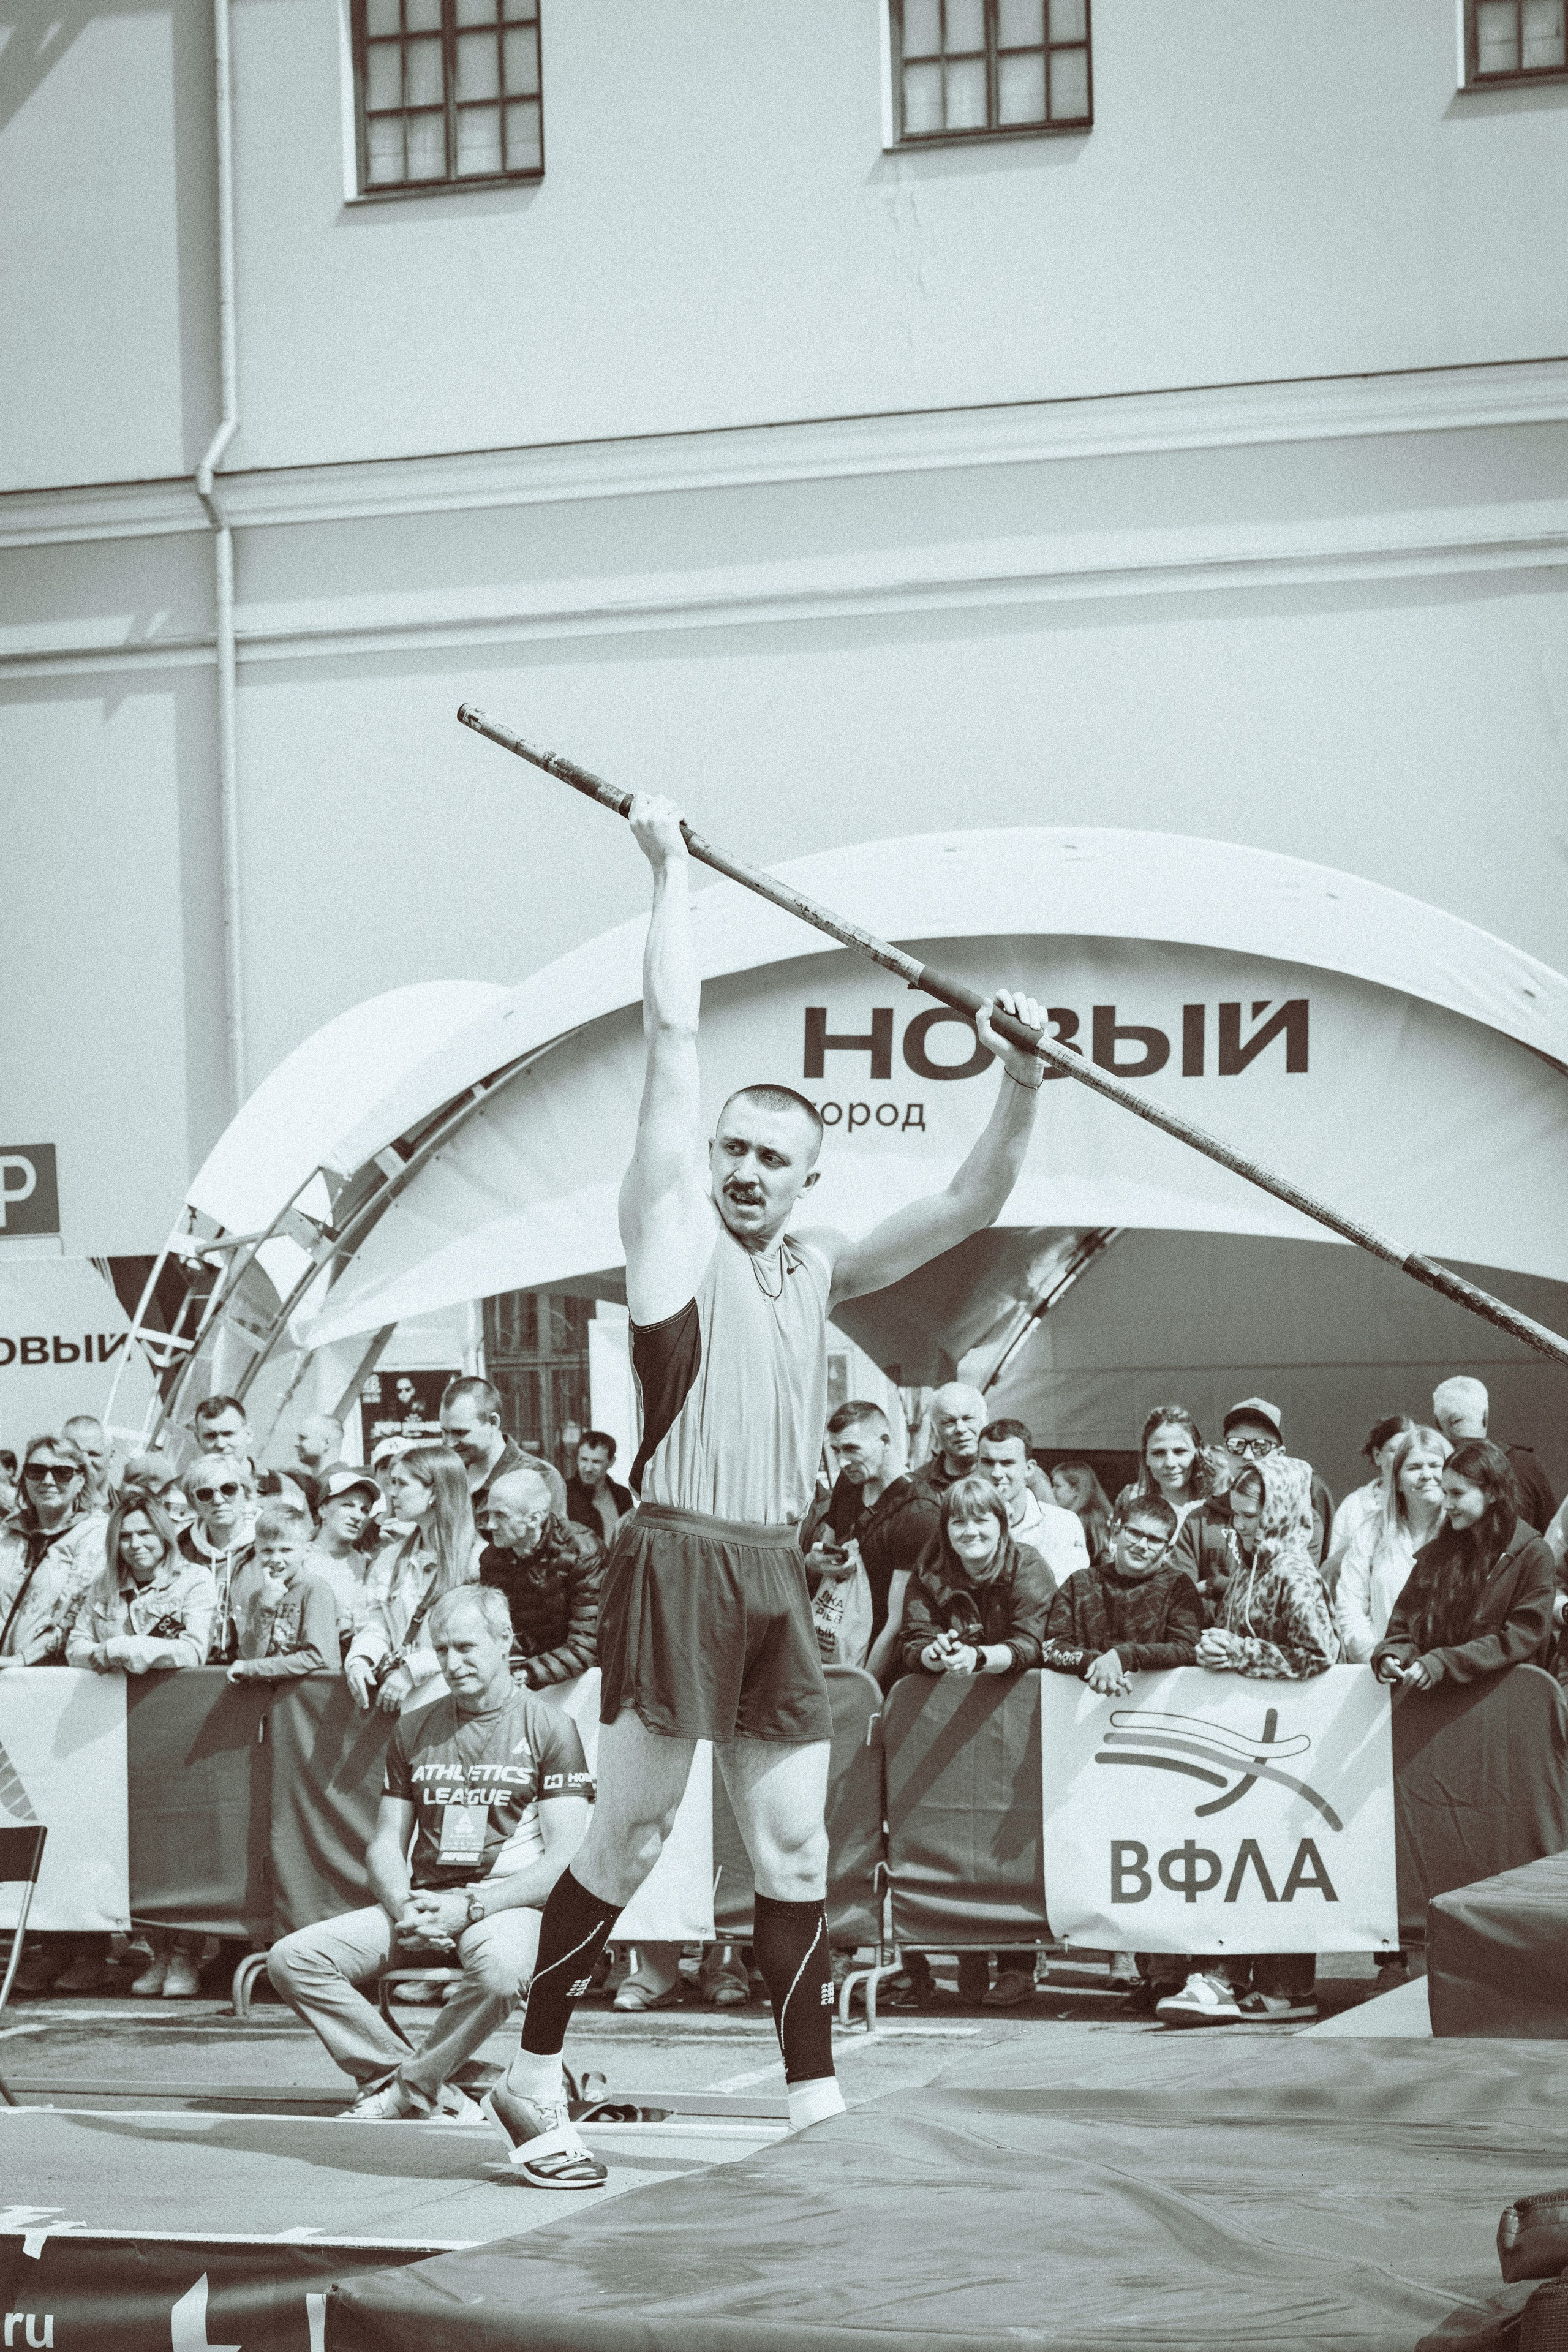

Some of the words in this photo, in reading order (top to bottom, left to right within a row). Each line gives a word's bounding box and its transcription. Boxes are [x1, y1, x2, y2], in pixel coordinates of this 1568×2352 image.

[813, 1102, 926, 1133] ород
[411, 1764, 533, 1785] ATHLETICS
[423, 1787, 513, 1806] LEAGUE
[1110, 1838, 1339, 1903] ВФЛА
[4, 2312, 54, 2348] ru
